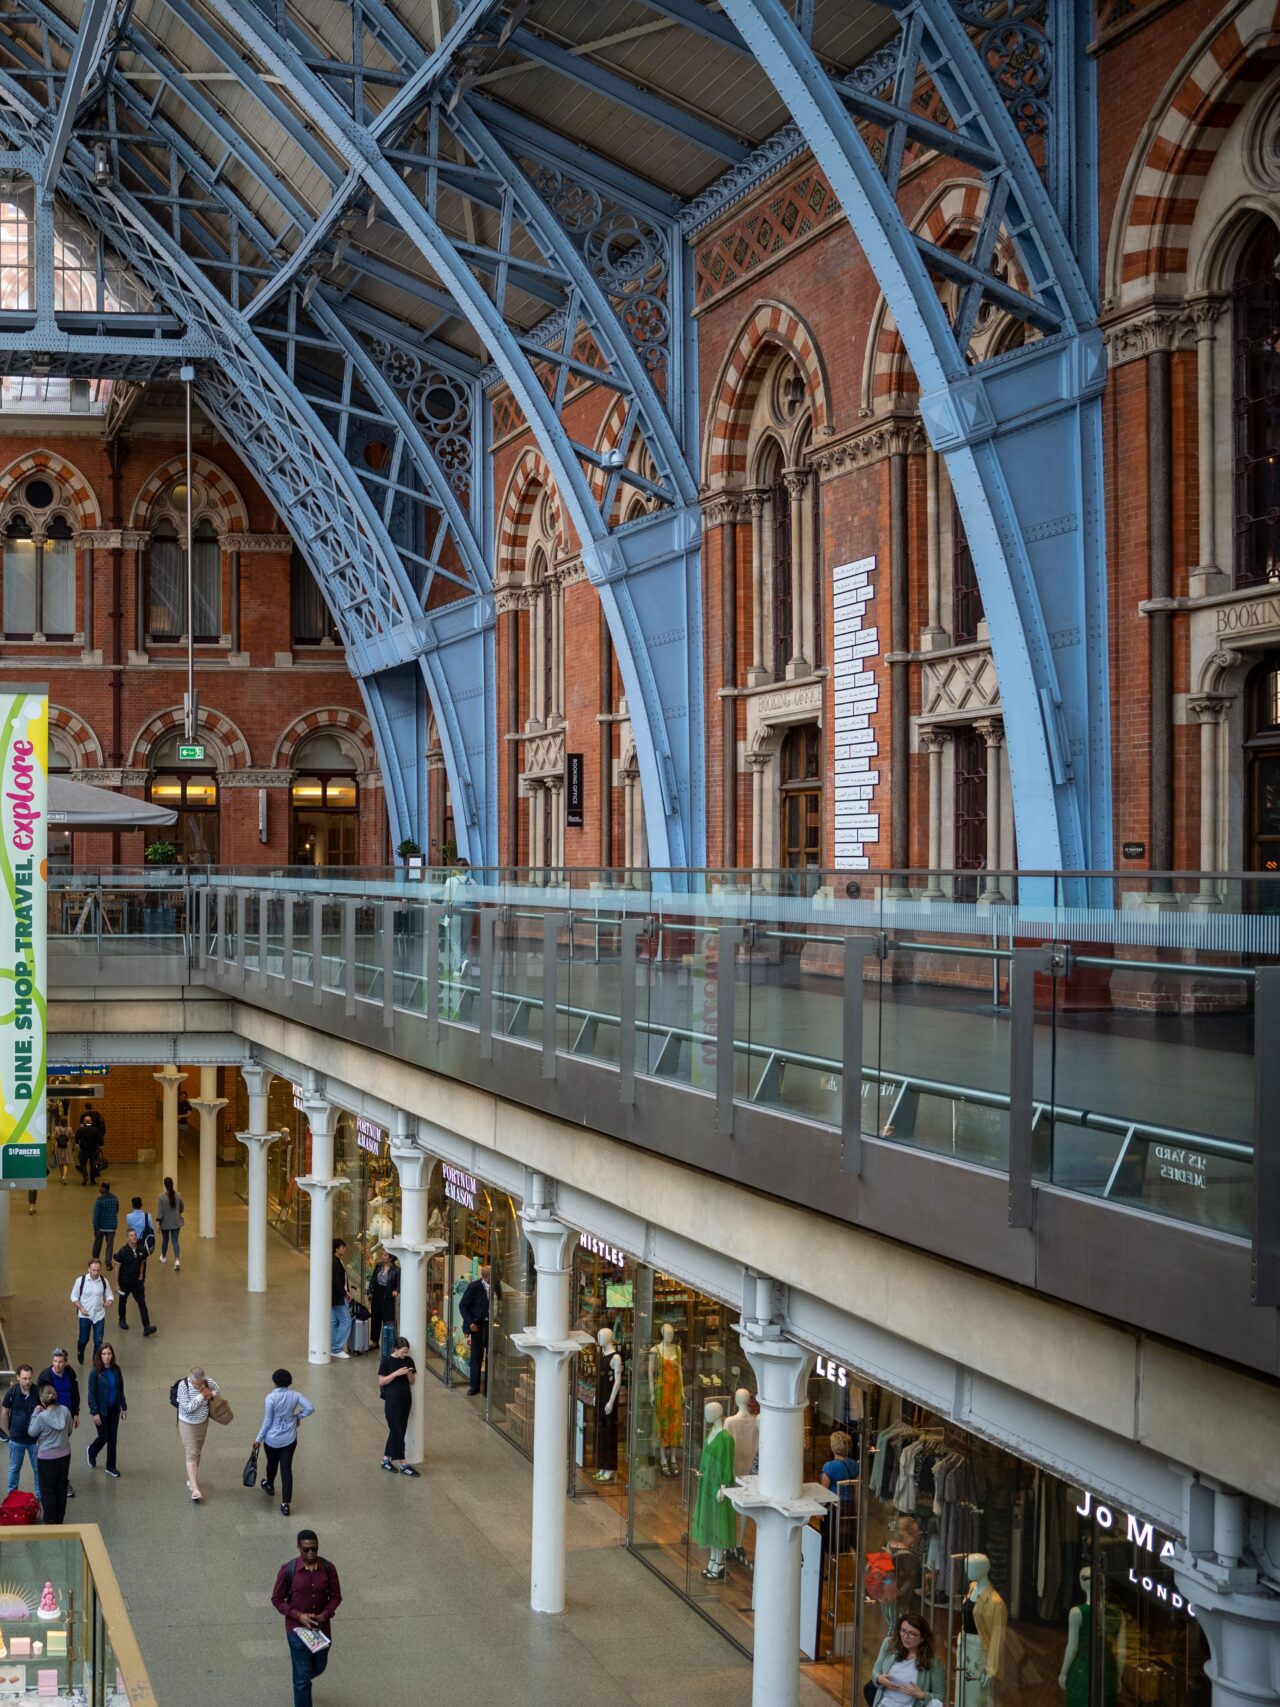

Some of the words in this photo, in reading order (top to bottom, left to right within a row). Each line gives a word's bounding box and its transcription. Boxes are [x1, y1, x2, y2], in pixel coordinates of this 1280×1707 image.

[6, 739, 42, 851] explore
[14, 854, 35, 953] TRAVEL,
[14, 960, 35, 1031] SHOP,
[14, 1036, 34, 1100] DINE,
[356, 1117, 381, 1143] FORTNUM
[442, 1163, 477, 1195] FORTNUM
[580, 1232, 624, 1268] HISTLES
[816, 1355, 847, 1387] LES
